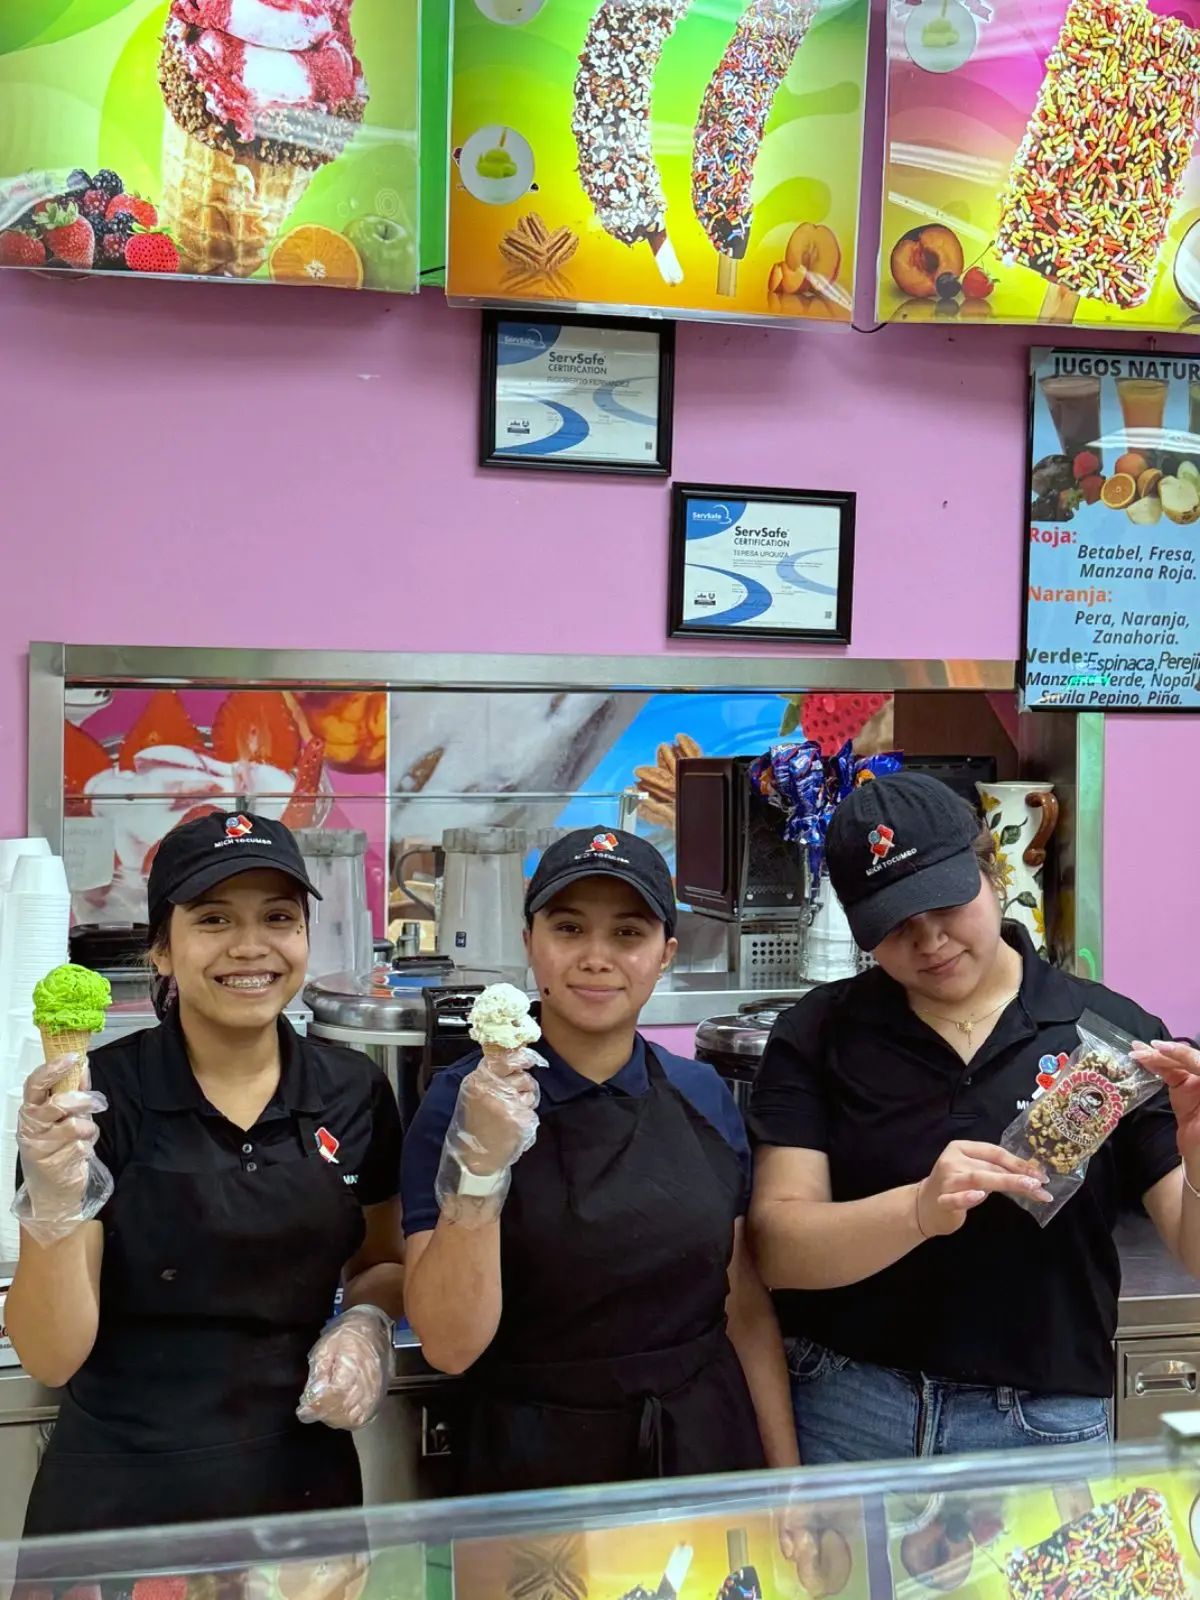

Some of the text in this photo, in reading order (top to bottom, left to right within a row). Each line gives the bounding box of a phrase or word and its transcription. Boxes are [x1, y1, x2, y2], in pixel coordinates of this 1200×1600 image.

[548, 351, 605, 366] ServSafe
[548, 365, 607, 375] CERTIFICATION
[1054, 357, 1200, 380] JUGOS NATUR
[692, 511, 722, 520] ServSafe
[734, 525, 788, 539] ServSafe
[1029, 527, 1077, 548] Roja:
[733, 537, 790, 548] CERTIFICATION
[733, 549, 759, 557] TERESA
[1077, 545, 1196, 564] Betabel, Fresa,
[1079, 564, 1197, 583] Manzana Roja.
[1028, 586, 1113, 607] Naranja:
[1075, 610, 1190, 629] Pera, Naranja,
[1092, 629, 1179, 645] Zanahoria.
[1026, 672, 1096, 686] Manzana
[1100, 673, 1146, 688] Verde,
[1040, 690, 1182, 707] Savila Pepino, Piña.
[882, 847, 917, 868] TOCUMBO
